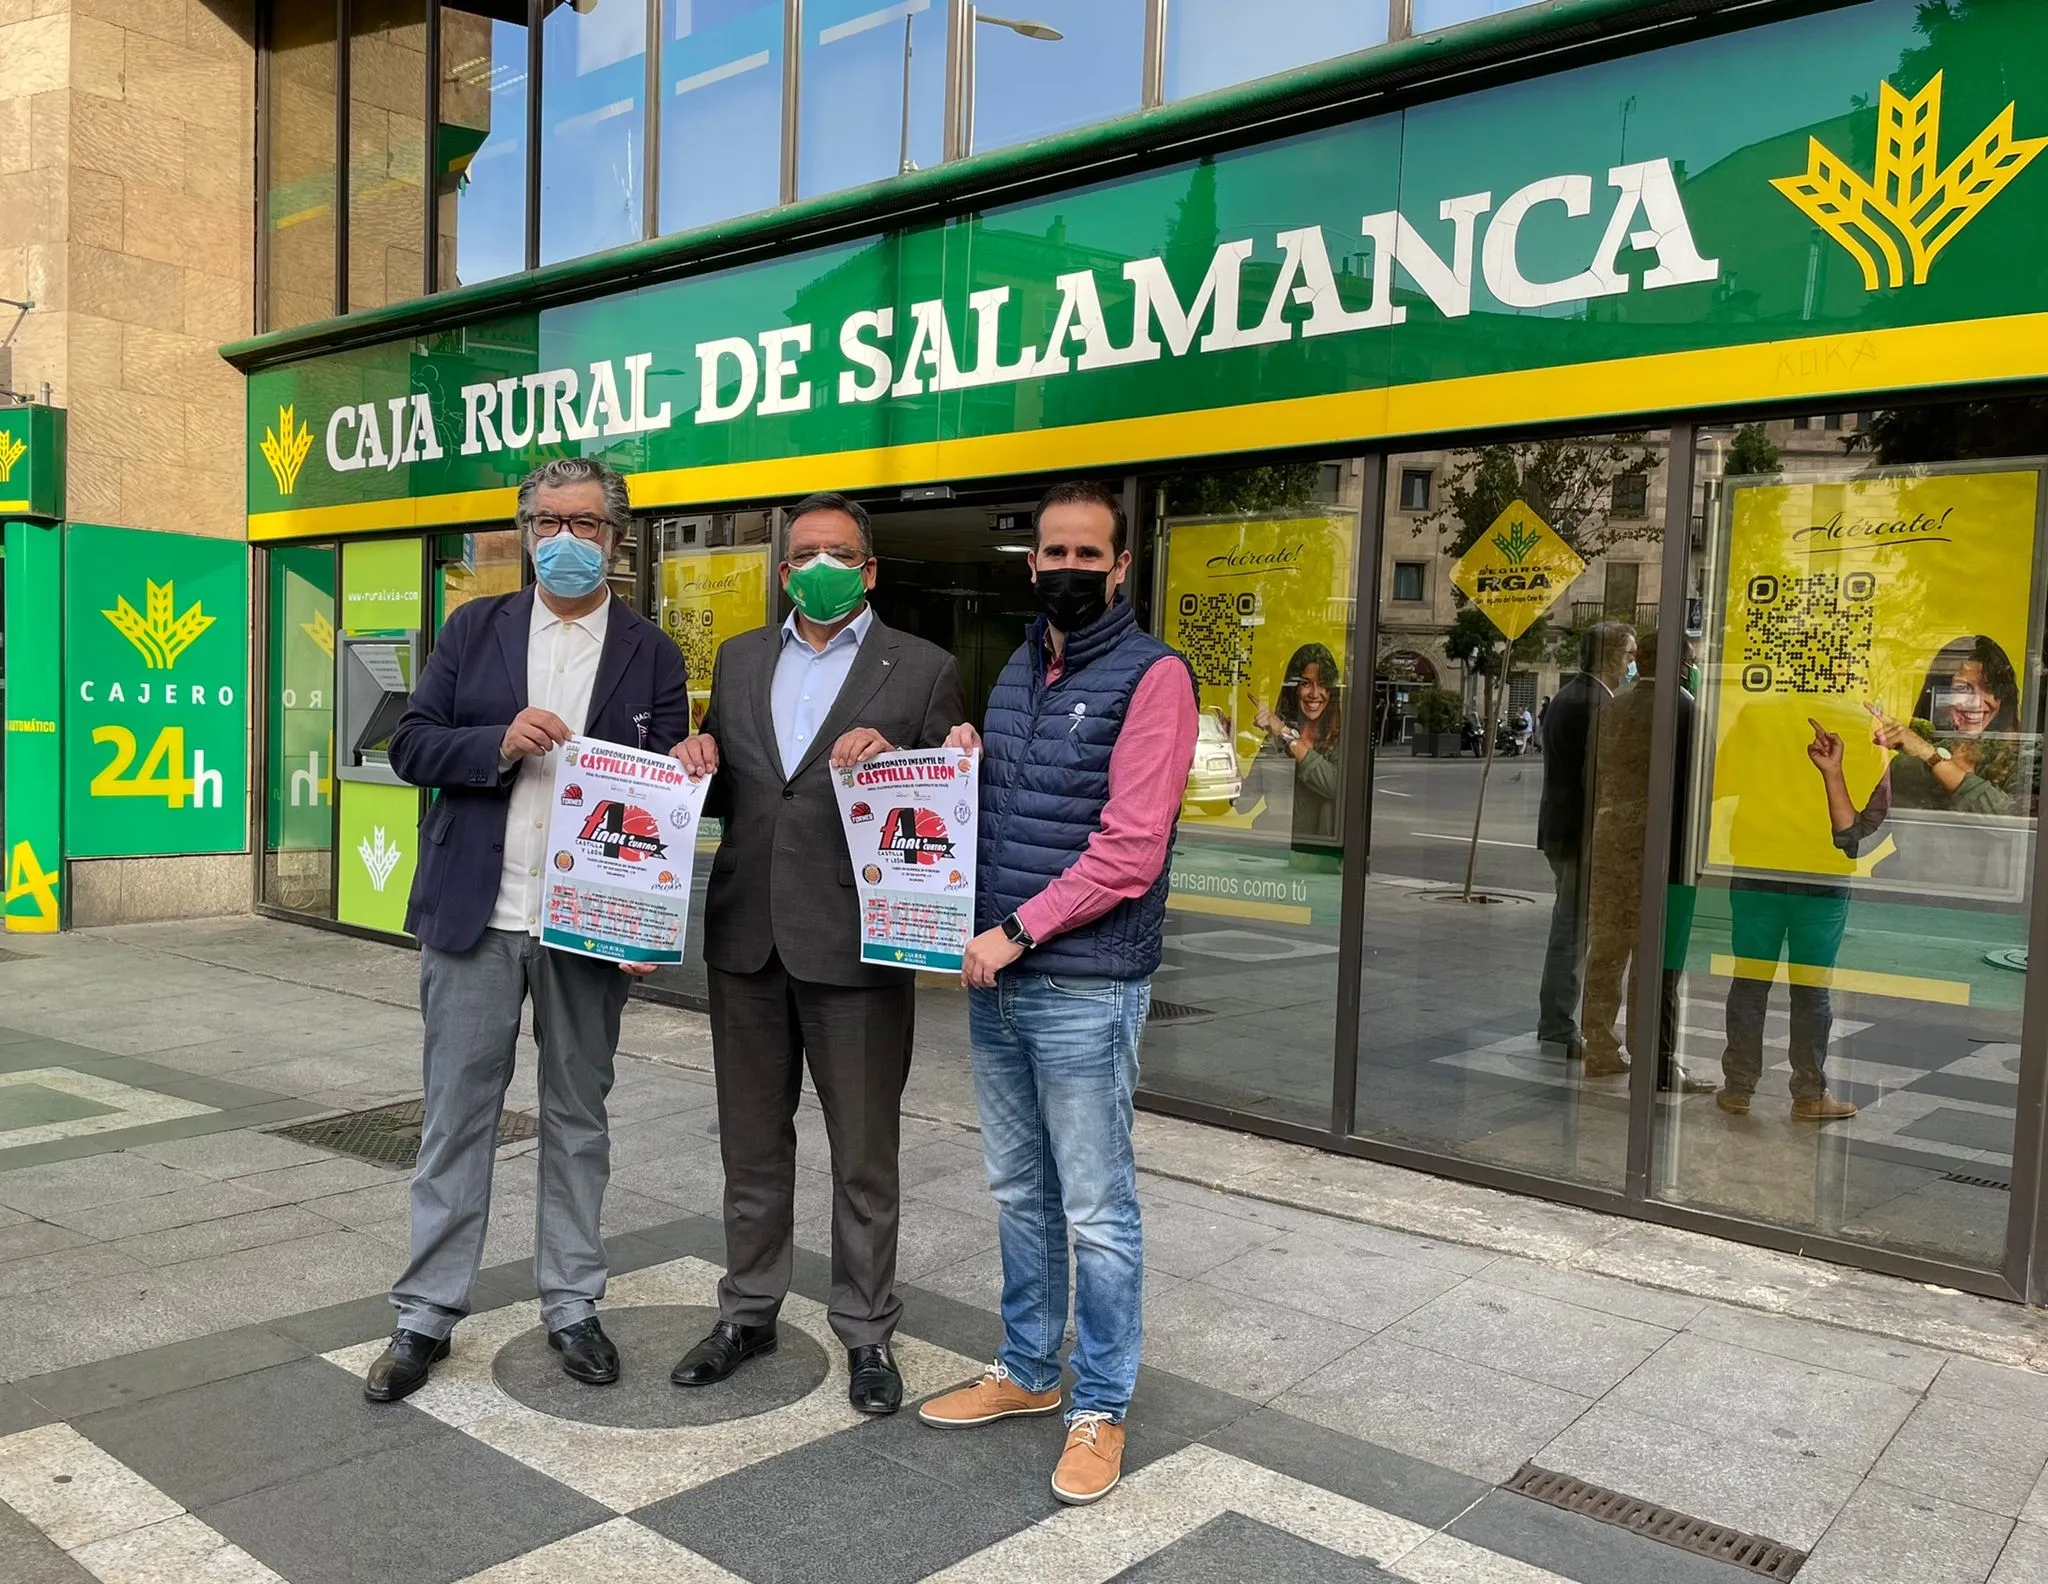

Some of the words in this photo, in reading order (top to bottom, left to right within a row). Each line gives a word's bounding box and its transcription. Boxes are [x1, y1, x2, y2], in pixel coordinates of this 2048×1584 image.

[326, 392, 443, 472] CAJA
[460, 352, 671, 456] RURAL
[694, 323, 814, 424] DE
[837, 157, 1719, 405] SALAMANCA
[1478, 564, 1553, 576] SEGUROS
[1477, 573, 1551, 593] RGA
[348, 589, 418, 602] www.ruralvia.com
[80, 680, 234, 706] CAJERO
[90, 725, 223, 809] 24h
[579, 753, 637, 777] CASTILLA
[640, 765, 650, 778] Y
[651, 767, 685, 785] LEÓN
[857, 767, 914, 786] CASTILLA
[916, 766, 924, 780] Y
[928, 764, 956, 780] LEÓN
[575, 839, 603, 849] CASTILLA
[1169, 871, 1239, 894] ensamos
[1243, 879, 1287, 899] como
[1292, 879, 1307, 901] tú
